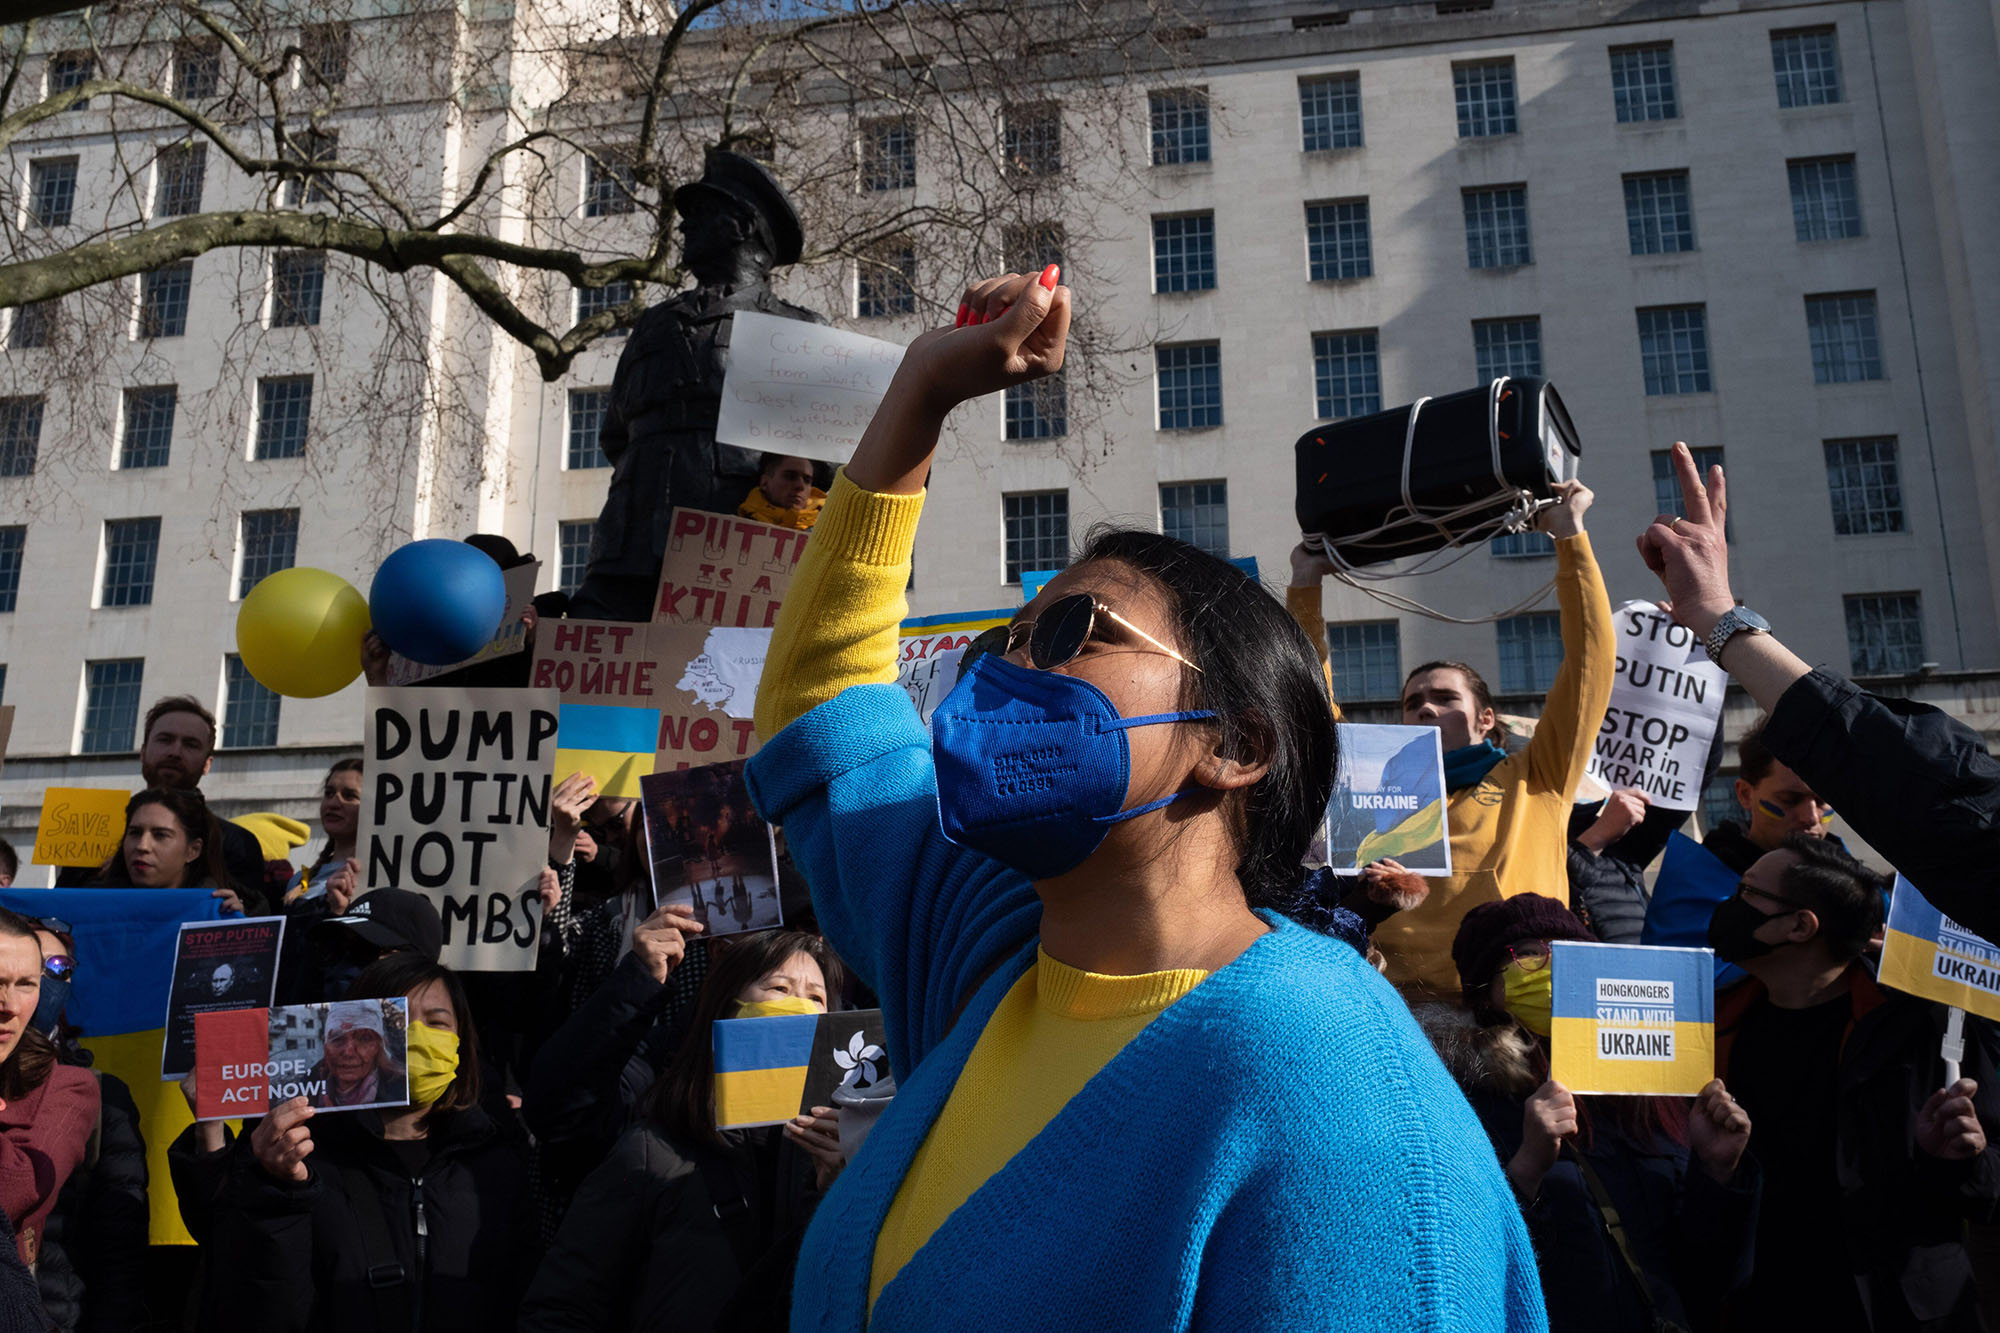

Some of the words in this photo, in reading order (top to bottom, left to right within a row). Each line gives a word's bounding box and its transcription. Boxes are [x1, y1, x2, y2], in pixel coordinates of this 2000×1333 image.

[870, 342, 897, 366] Put
[764, 358, 809, 380] from
[810, 401, 841, 416] can
[696, 563, 733, 589] IS
[751, 575, 772, 595] A
[554, 624, 634, 655] НЕТ
[533, 656, 658, 696] ВОЙНЕ
[375, 707, 559, 762] DUMP
[658, 715, 755, 755] NOT
[1600, 707, 1690, 750] STOP
[1595, 735, 1656, 769] WAR
[1659, 752, 1681, 776] in
[1352, 794, 1419, 809] UKRAINE
[46, 802, 111, 838] SAVE
[367, 831, 498, 888] NOT
[420, 888, 543, 949] MBS
[184, 931, 223, 945] STOP
[1937, 935, 1986, 962] STAND
[1600, 983, 1670, 999] HONGKONGERS
[1596, 1007, 1640, 1027] STAND
[1642, 1008, 1675, 1028] WITH
[1601, 1032, 1671, 1057] UKRAINE
[222, 1059, 312, 1080] EUROPE,
[221, 1085, 262, 1104] ACT
[268, 1080, 327, 1100] NOW!
